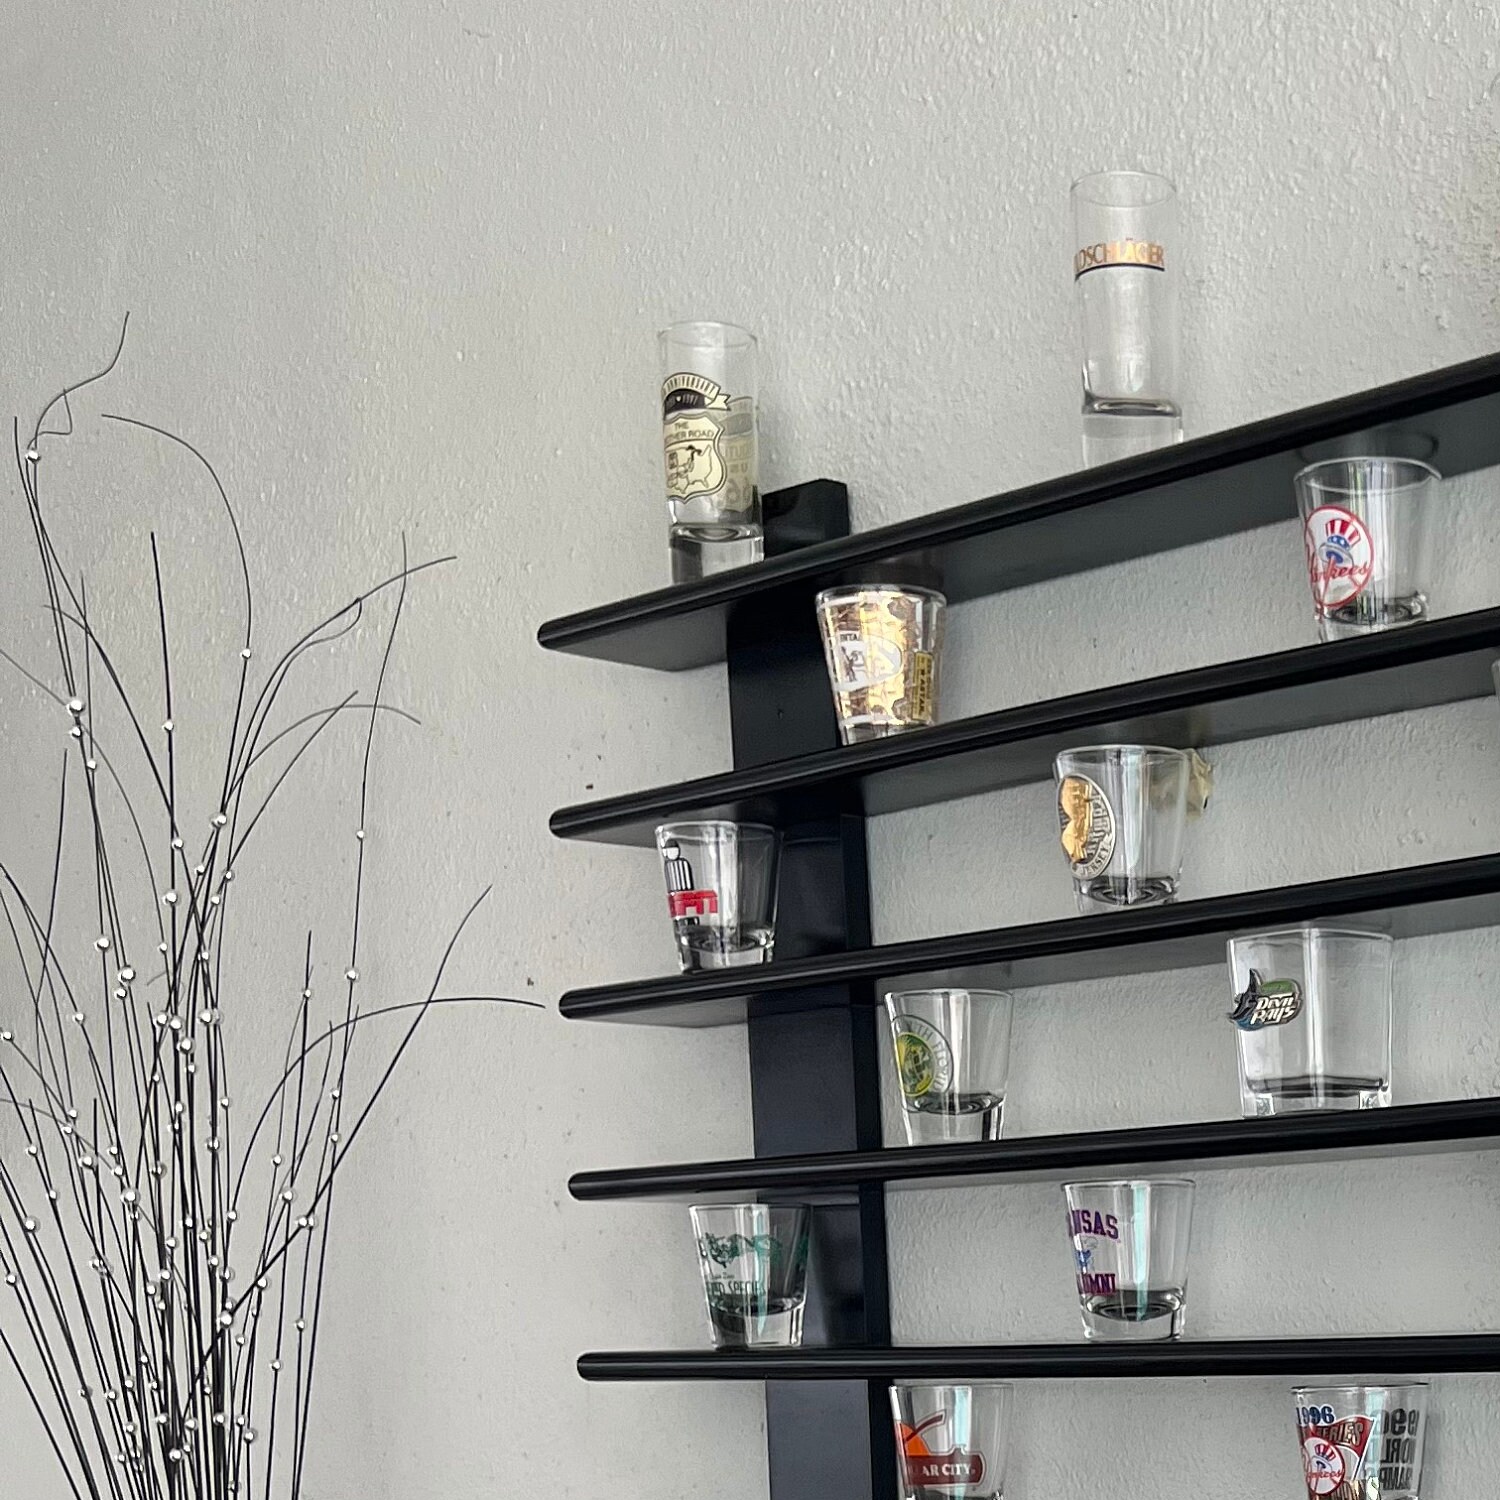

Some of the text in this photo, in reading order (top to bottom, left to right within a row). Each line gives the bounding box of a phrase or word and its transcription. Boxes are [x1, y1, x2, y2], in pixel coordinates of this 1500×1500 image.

[674, 421, 689, 430] THE
[688, 429, 715, 438] ROAD
[1296, 1404, 1335, 1426] 1996
[941, 1463, 971, 1476] CITY
